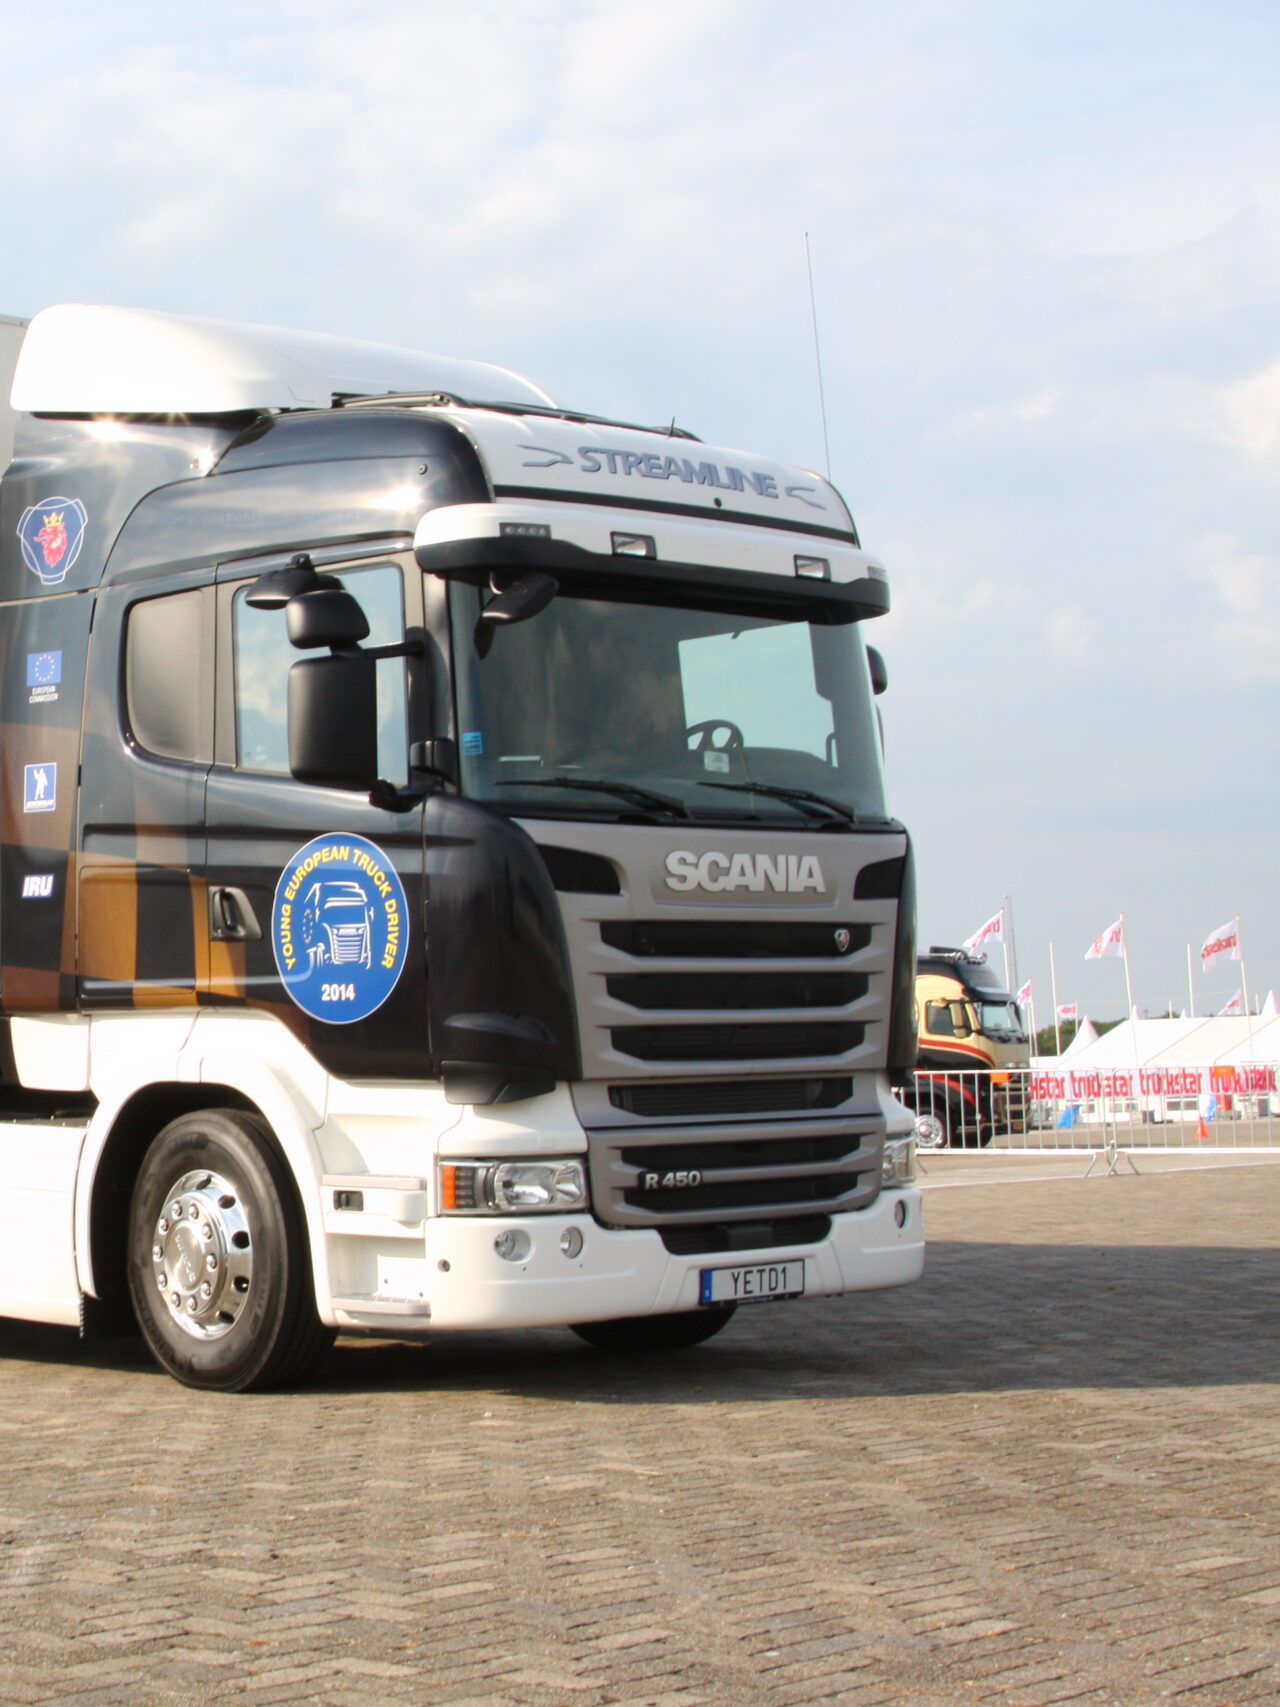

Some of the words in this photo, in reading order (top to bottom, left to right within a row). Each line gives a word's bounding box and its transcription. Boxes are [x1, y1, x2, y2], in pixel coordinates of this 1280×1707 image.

[577, 446, 779, 499] STREAMLINE
[22, 875, 54, 897] IRU
[284, 846, 350, 901] EUROPEAN
[353, 849, 393, 899] TRUCK
[663, 850, 826, 894] SCANIA
[280, 904, 297, 970] YOUNG
[380, 899, 400, 970] DRIVER
[321, 984, 355, 1001] 2014
[645, 1173, 659, 1189] R
[661, 1170, 701, 1188] 450
[731, 1266, 787, 1296] YETD1
